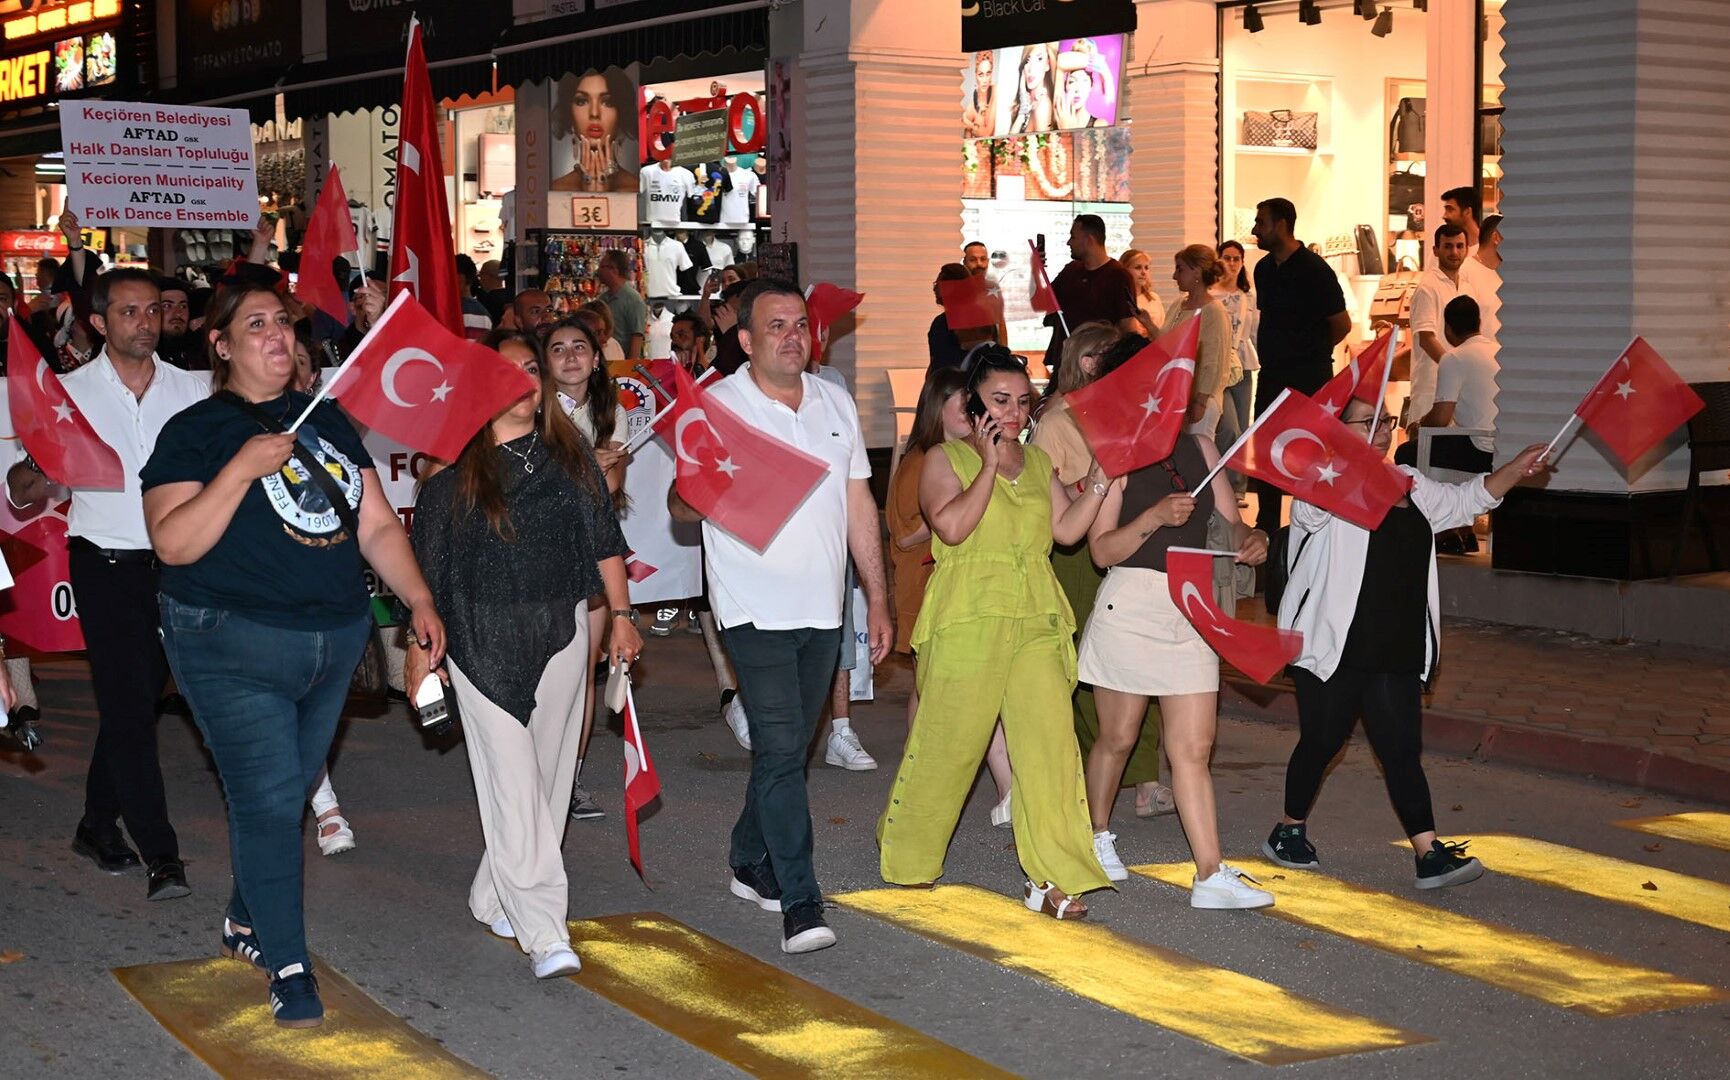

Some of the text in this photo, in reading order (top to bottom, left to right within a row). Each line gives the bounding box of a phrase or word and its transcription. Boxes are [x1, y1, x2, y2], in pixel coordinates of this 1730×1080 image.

[983, 0, 1046, 18] Black Cat
[83, 107, 231, 127] Keçiören Belediyesi
[123, 127, 179, 142] AFTAD
[70, 143, 249, 163] Halk Dansları Topluluğu
[82, 172, 244, 191] Kecioren Municipality
[130, 191, 186, 205] AFTAD
[650, 193, 680, 203] BMW
[85, 207, 249, 222] Folk Dance Ensemble
[581, 206, 602, 222] 3€
